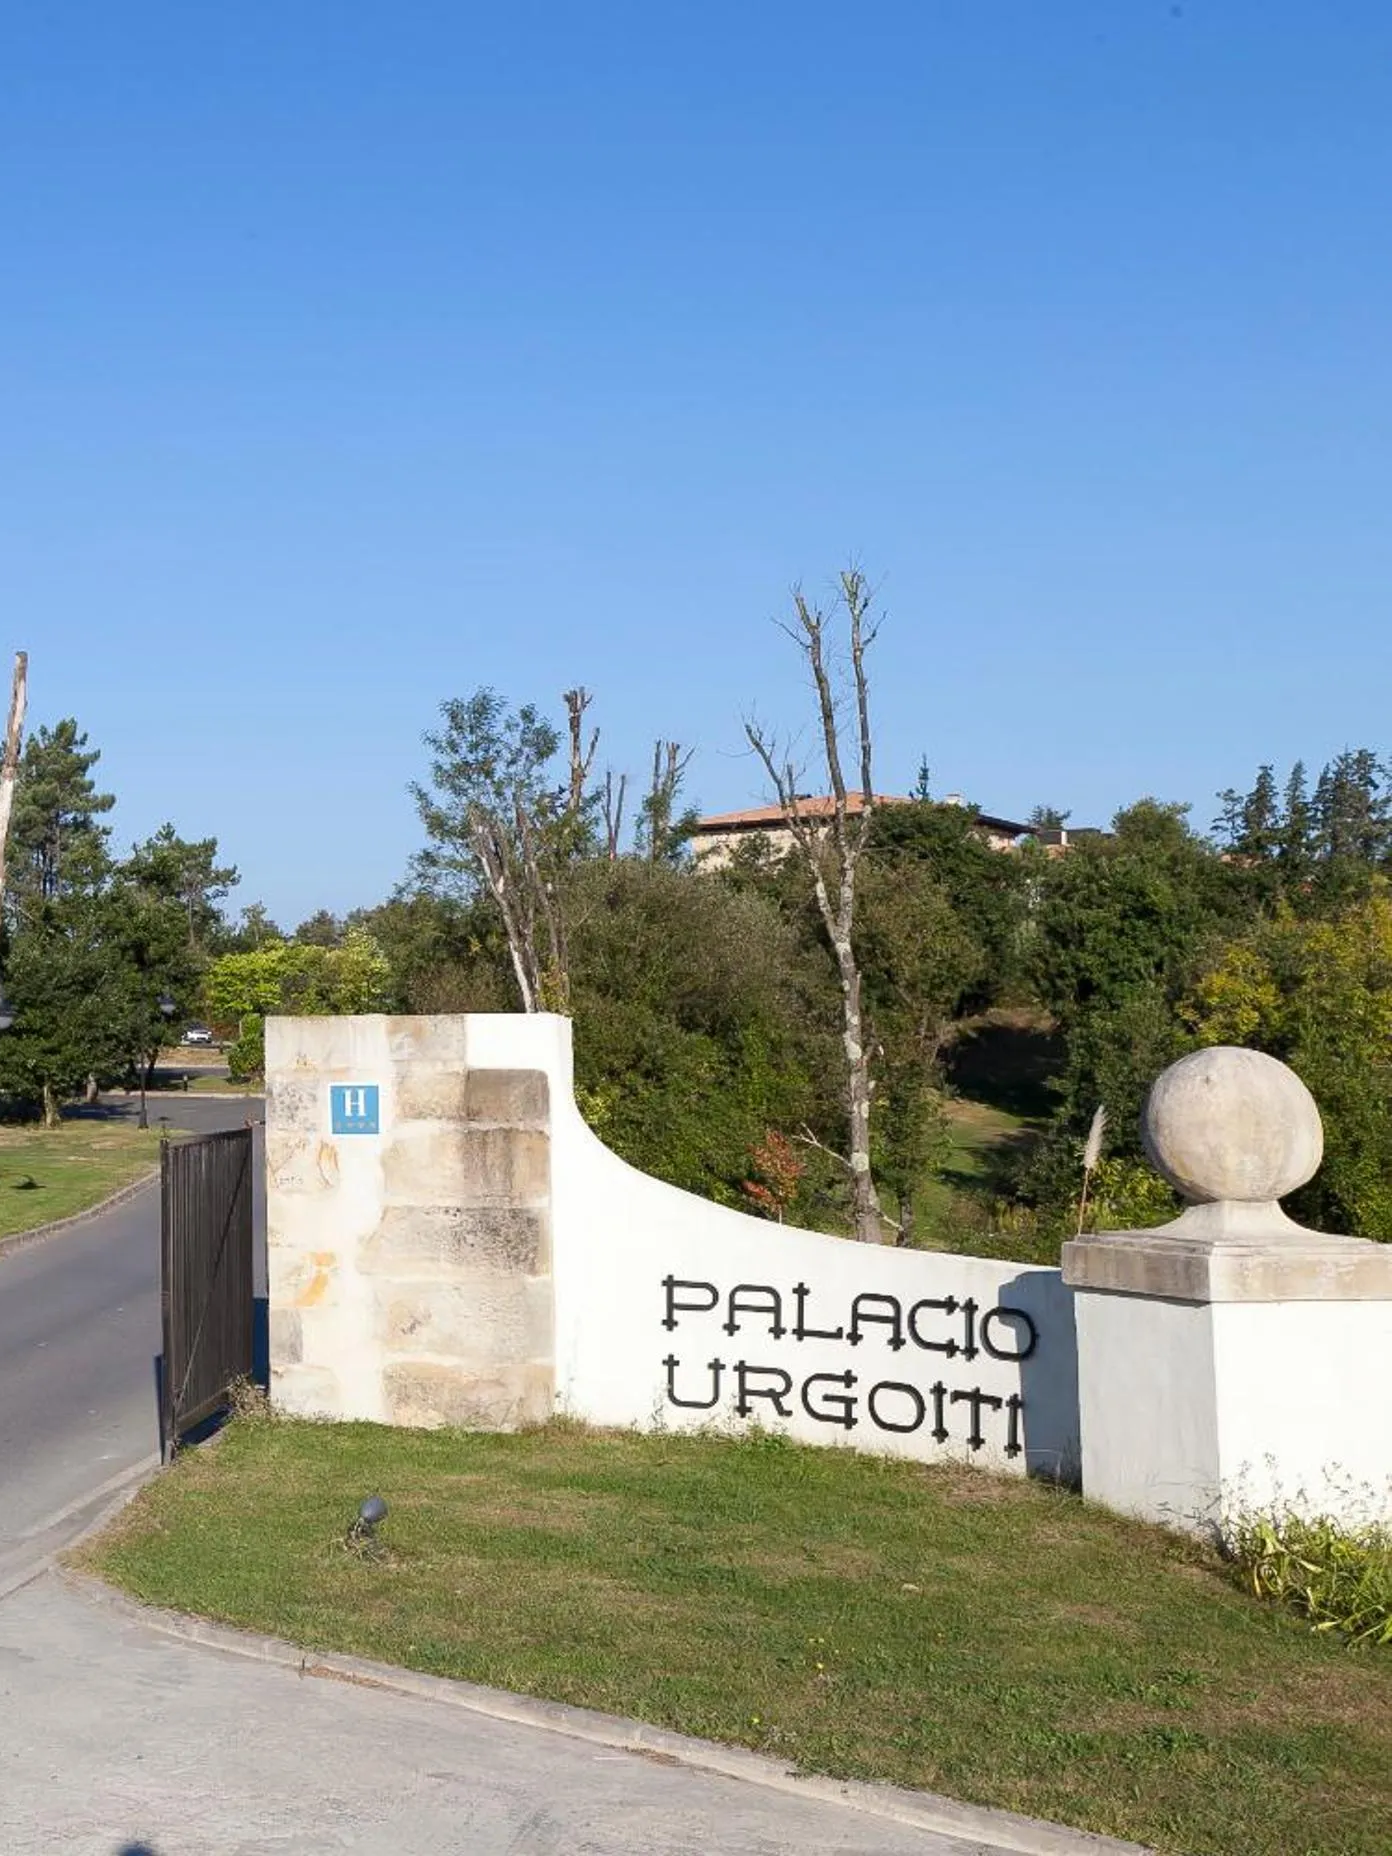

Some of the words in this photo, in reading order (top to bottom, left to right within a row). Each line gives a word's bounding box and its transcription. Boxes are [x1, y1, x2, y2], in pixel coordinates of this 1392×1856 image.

[344, 1088, 366, 1117] H
[661, 1274, 1040, 1362] PALACIO
[662, 1353, 1024, 1459] URGOITI
